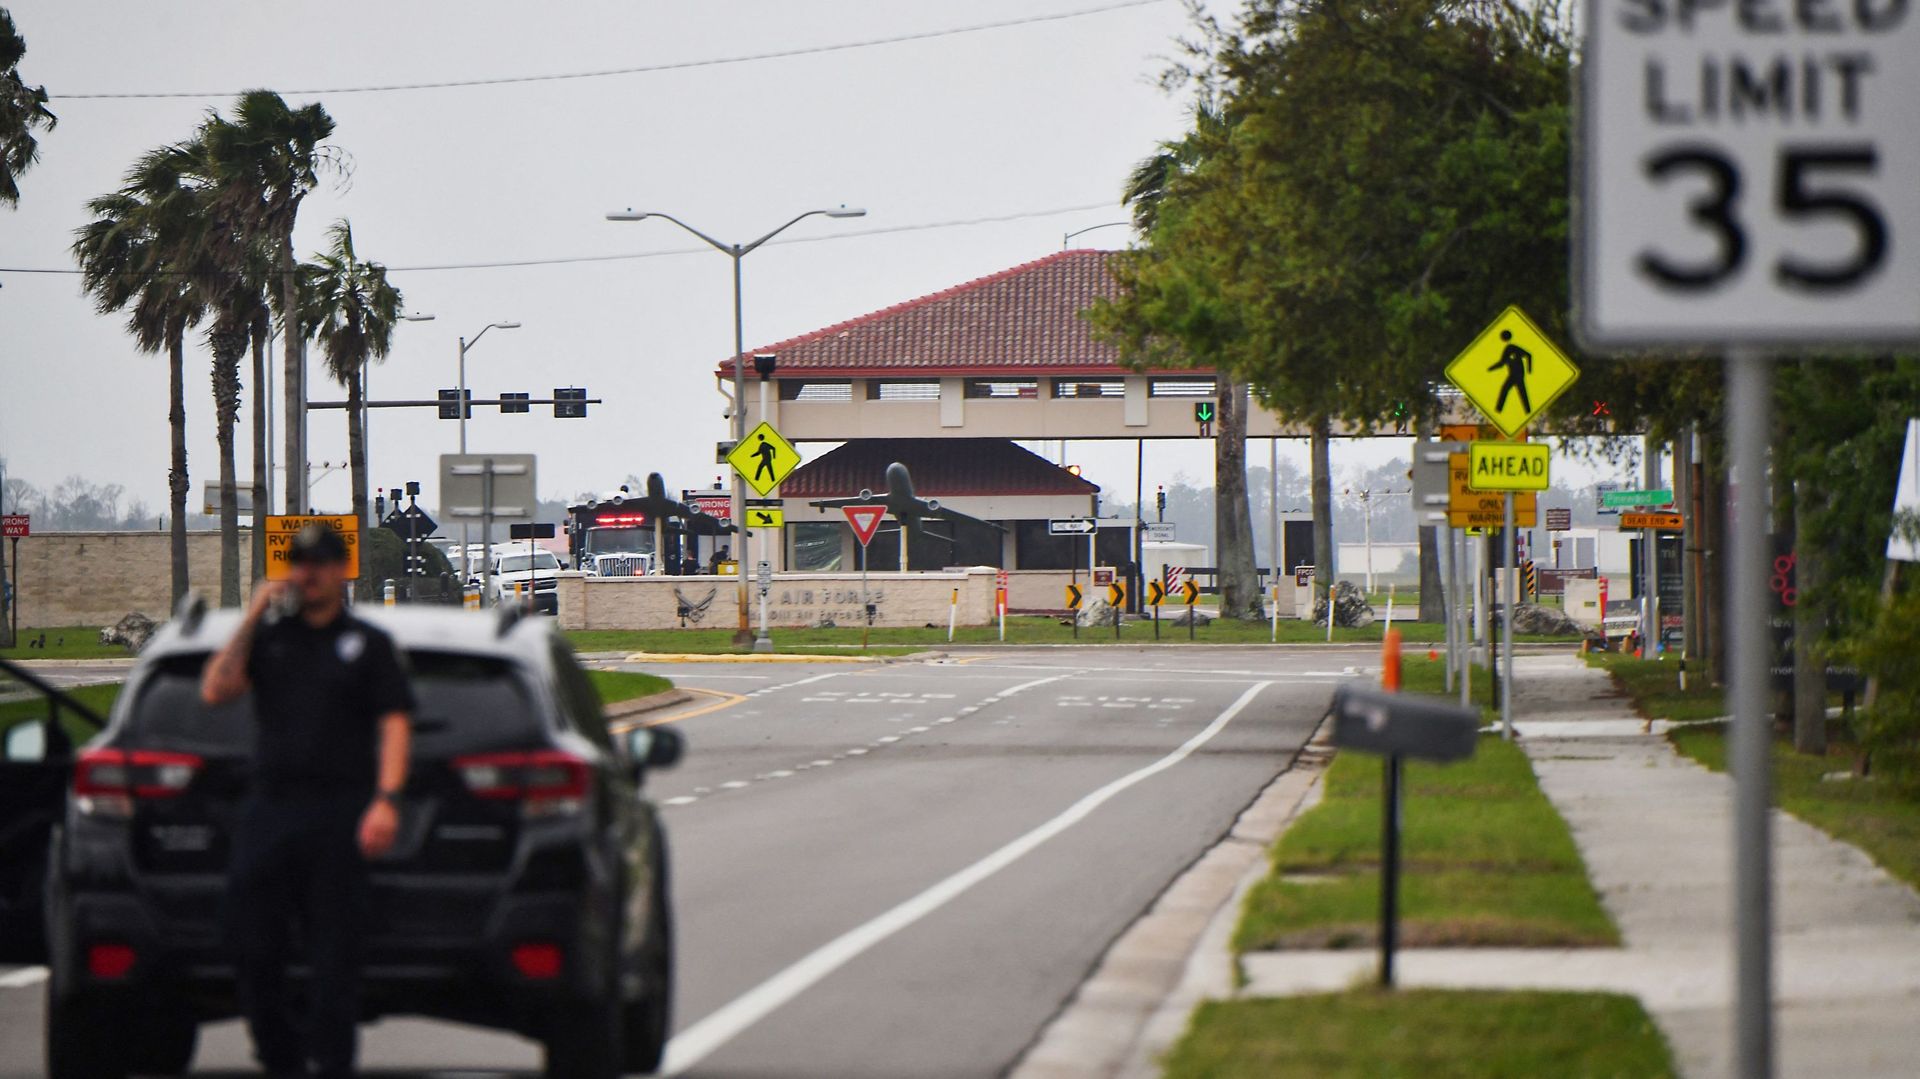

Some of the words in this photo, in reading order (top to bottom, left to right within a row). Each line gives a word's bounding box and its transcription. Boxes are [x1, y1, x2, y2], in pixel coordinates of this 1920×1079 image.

[1642, 52, 1877, 126] LIMIT
[1632, 140, 1910, 300] 35
[1201, 423, 1207, 437] 1
[1477, 456, 1544, 477] AHEAD
[1626, 517, 1647, 525] DEAD
[1650, 517, 1665, 525] END
[781, 591, 813, 605] AIR
